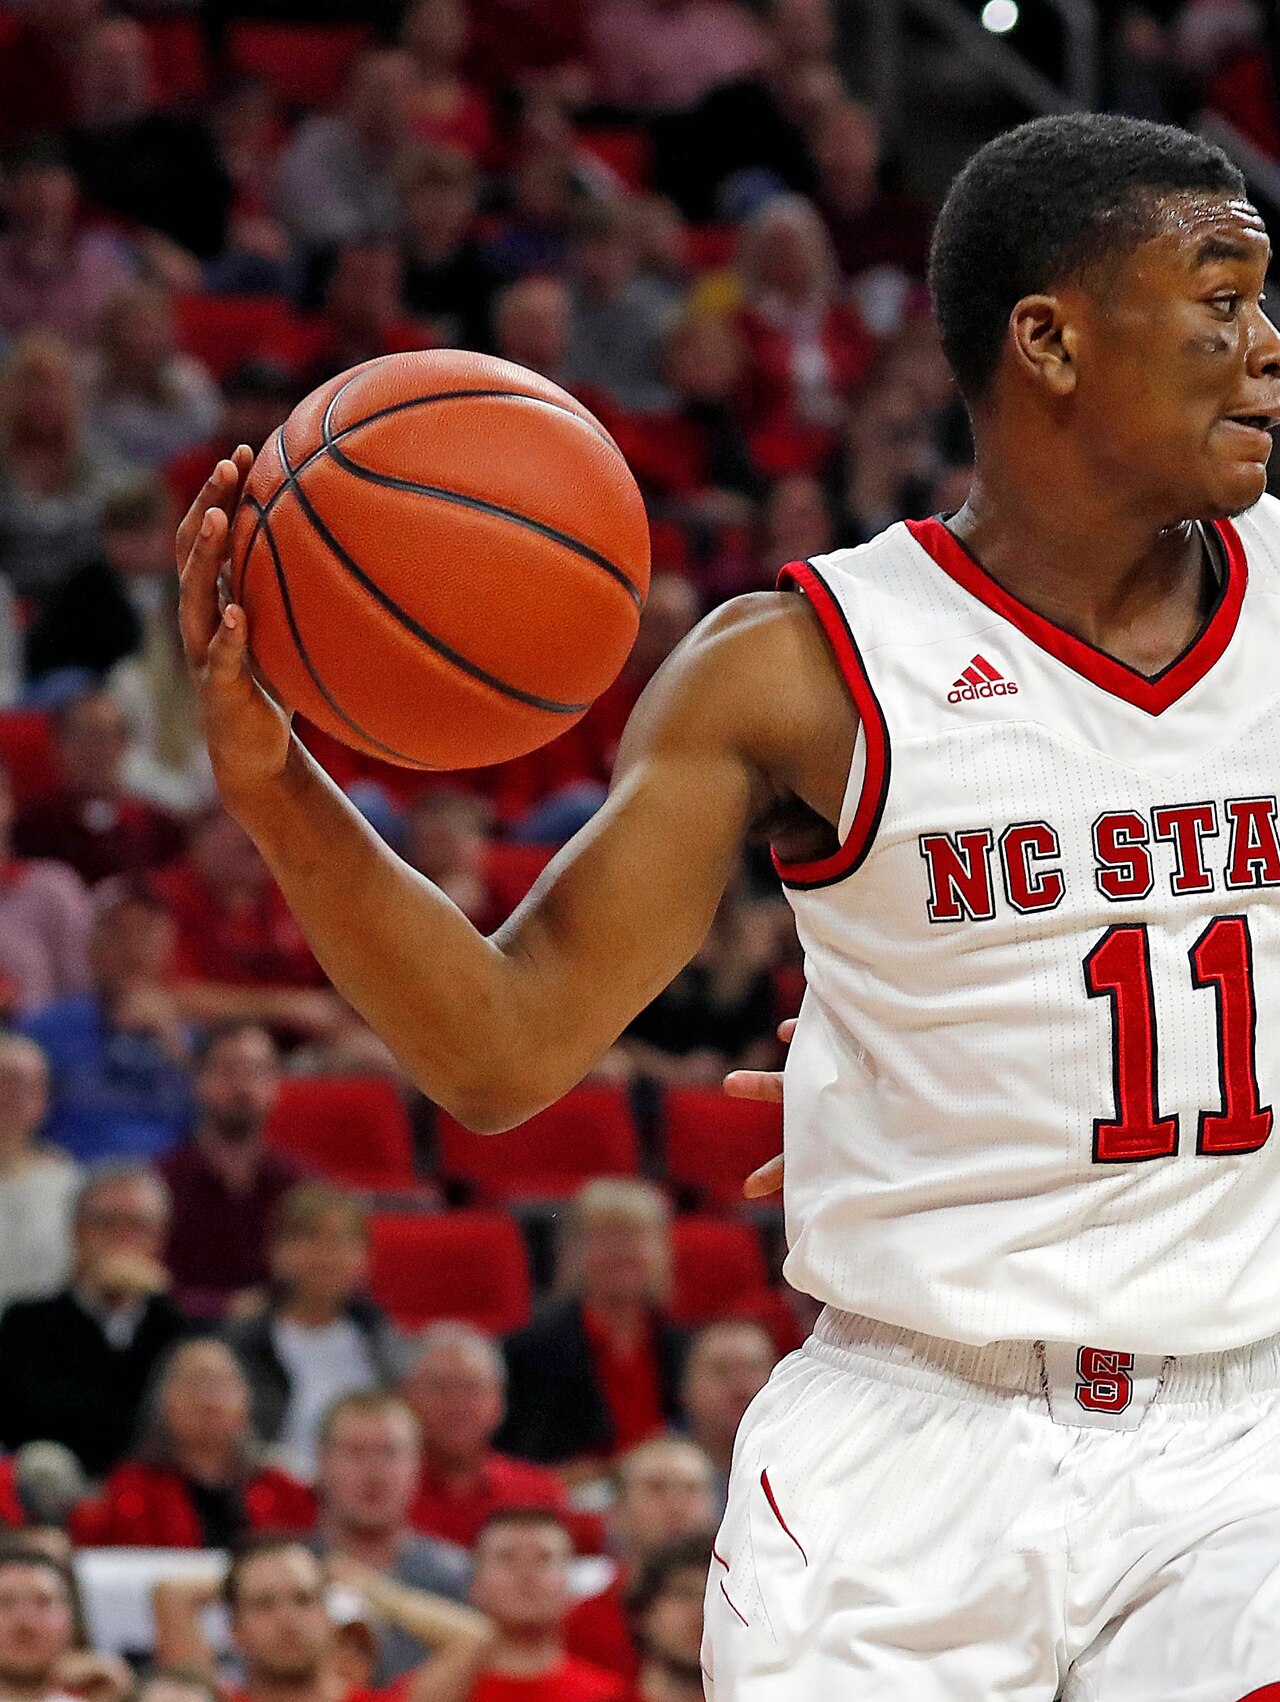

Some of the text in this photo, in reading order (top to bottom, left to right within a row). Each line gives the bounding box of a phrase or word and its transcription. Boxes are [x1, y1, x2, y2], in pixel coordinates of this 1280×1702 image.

[947, 681, 1018, 703] adidas
[920, 820, 1066, 923] NC
[1083, 914, 1273, 1164] 11
